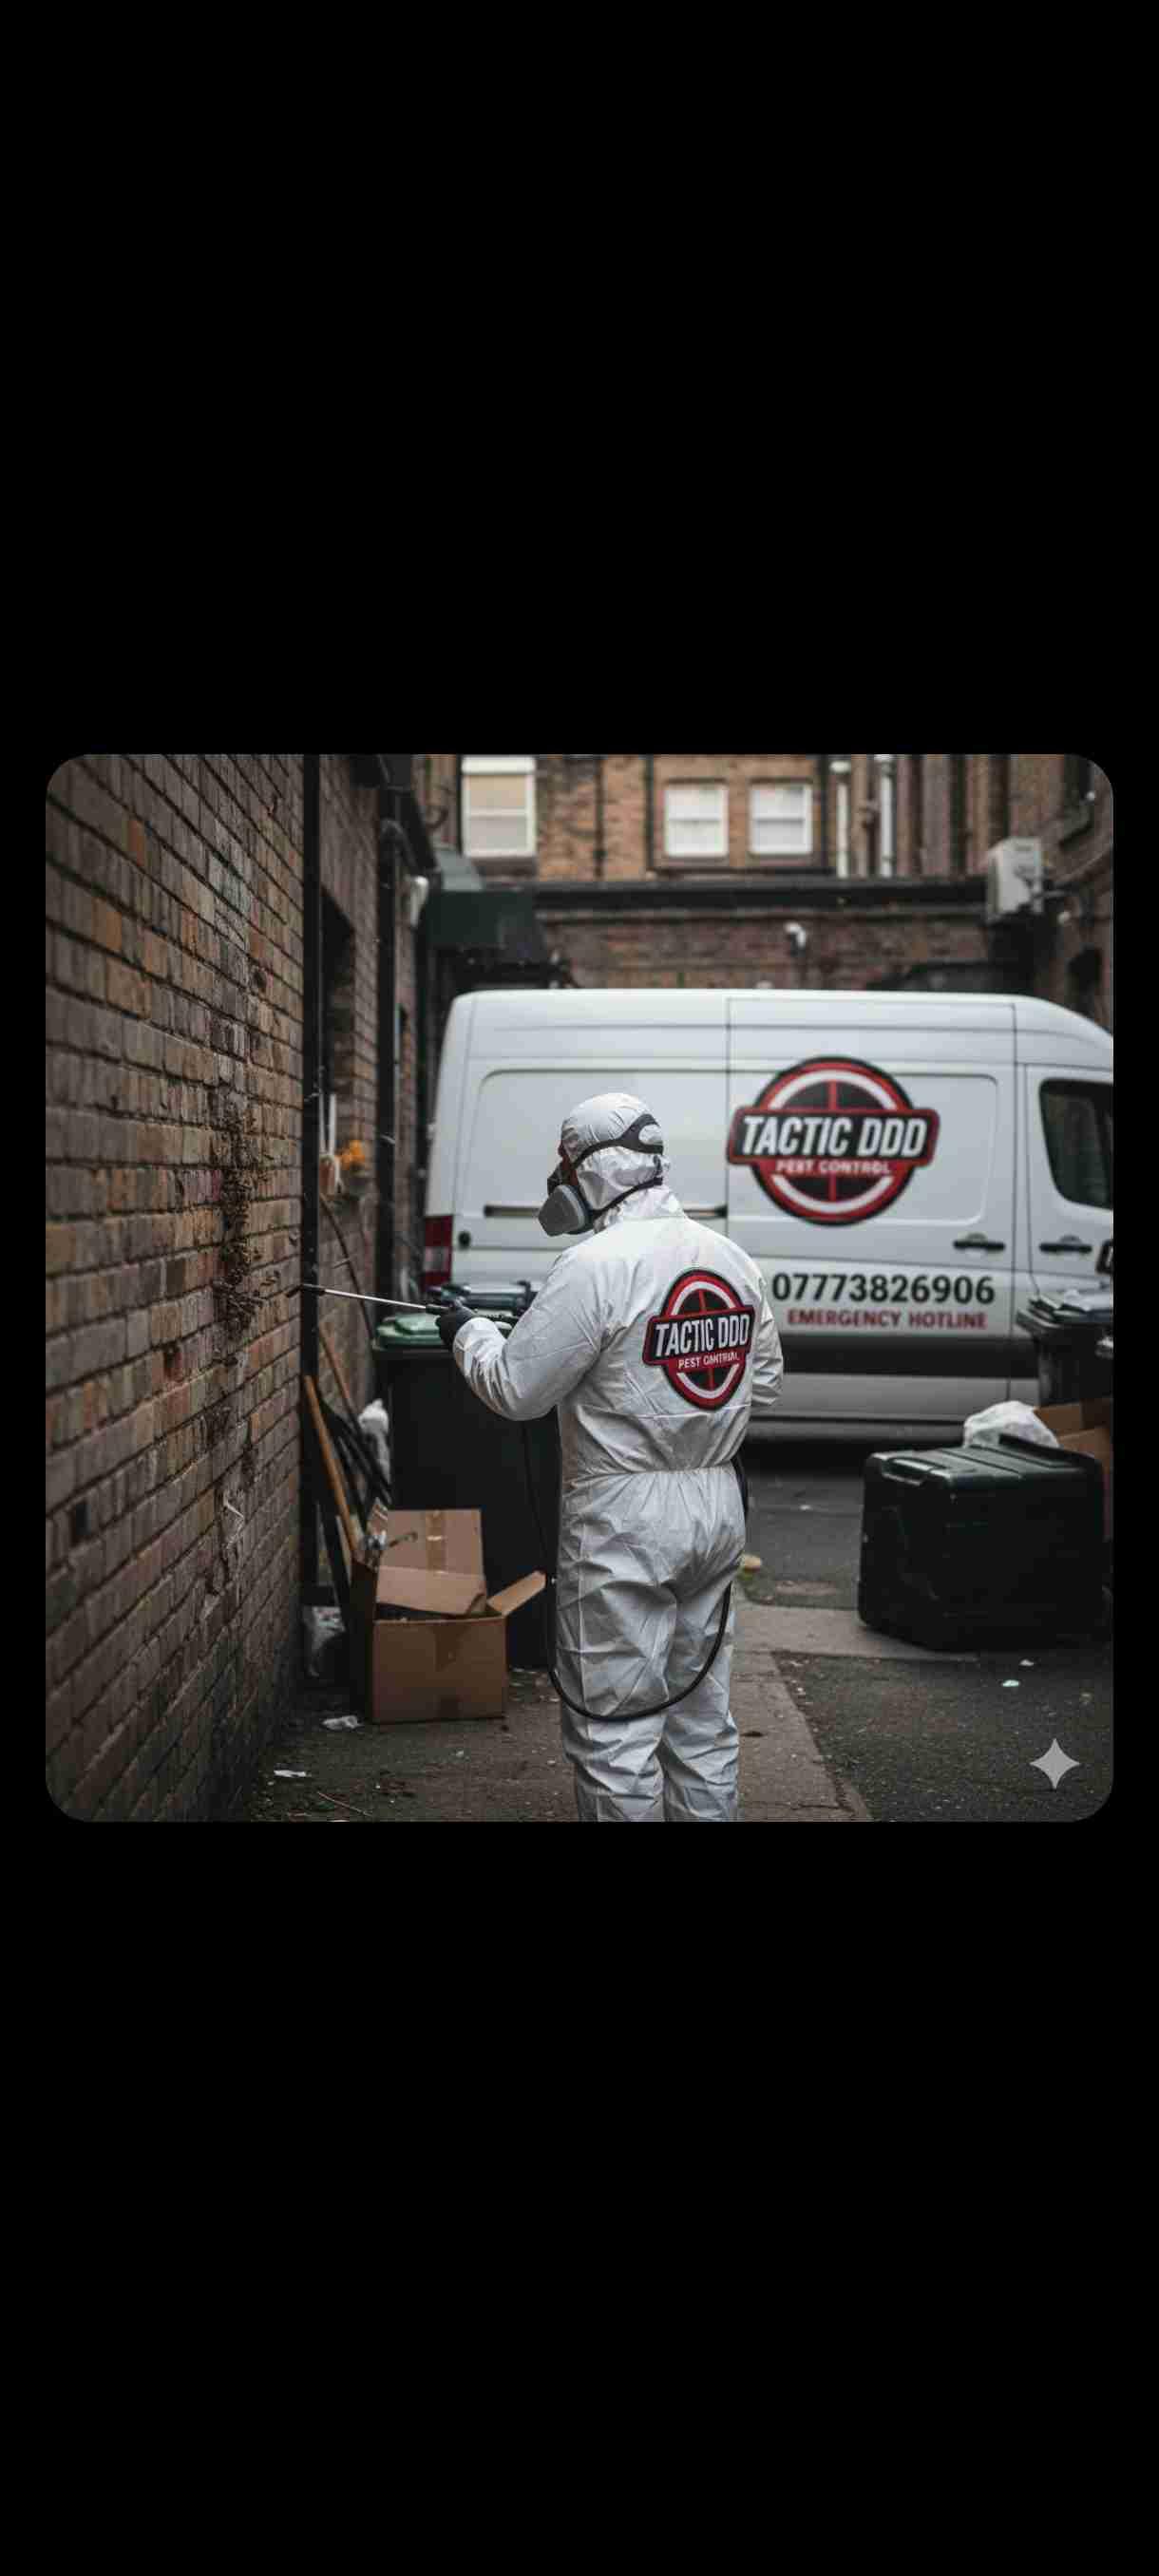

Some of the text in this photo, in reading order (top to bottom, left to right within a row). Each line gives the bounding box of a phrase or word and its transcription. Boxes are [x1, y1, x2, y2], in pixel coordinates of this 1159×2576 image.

[741, 1115, 928, 1158] TACTIC DDD
[775, 1160, 891, 1175] PEST CONTROL
[771, 1272, 996, 1305] 07773826906
[788, 1308, 988, 1331] EMERGENCY HOTLINE
[655, 1313, 750, 1358] TACTIC DDD
[677, 1356, 701, 1370] PEST
